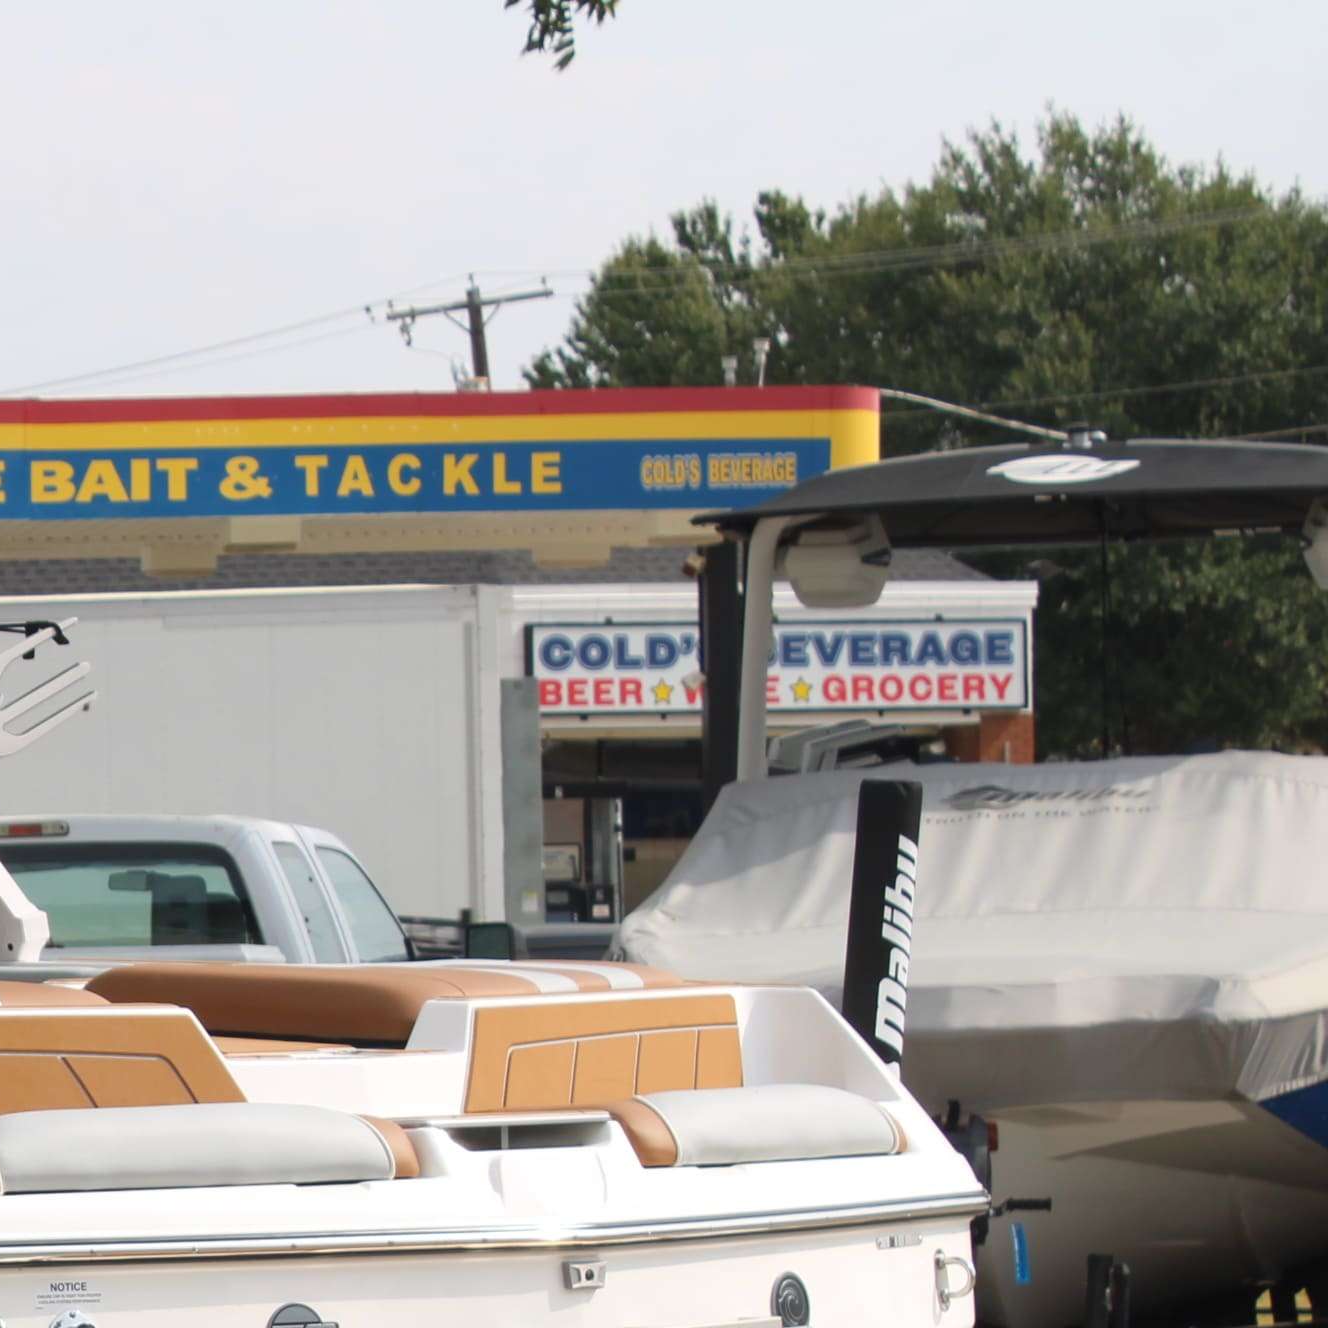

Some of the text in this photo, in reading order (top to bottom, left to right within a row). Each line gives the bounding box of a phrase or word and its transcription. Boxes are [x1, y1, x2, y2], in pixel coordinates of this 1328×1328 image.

[29, 457, 199, 504] BAIT
[218, 455, 273, 500] &
[294, 451, 563, 497] TACKLE
[641, 452, 798, 491] COLD'S BEVERAGE
[539, 633, 701, 671] COLD'
[766, 628, 1016, 669] EVERAGE
[538, 676, 644, 707] BEER
[821, 672, 1015, 704] GROCERY
[875, 834, 919, 1057] Malibu
[50, 1281, 88, 1292] NOTICE
